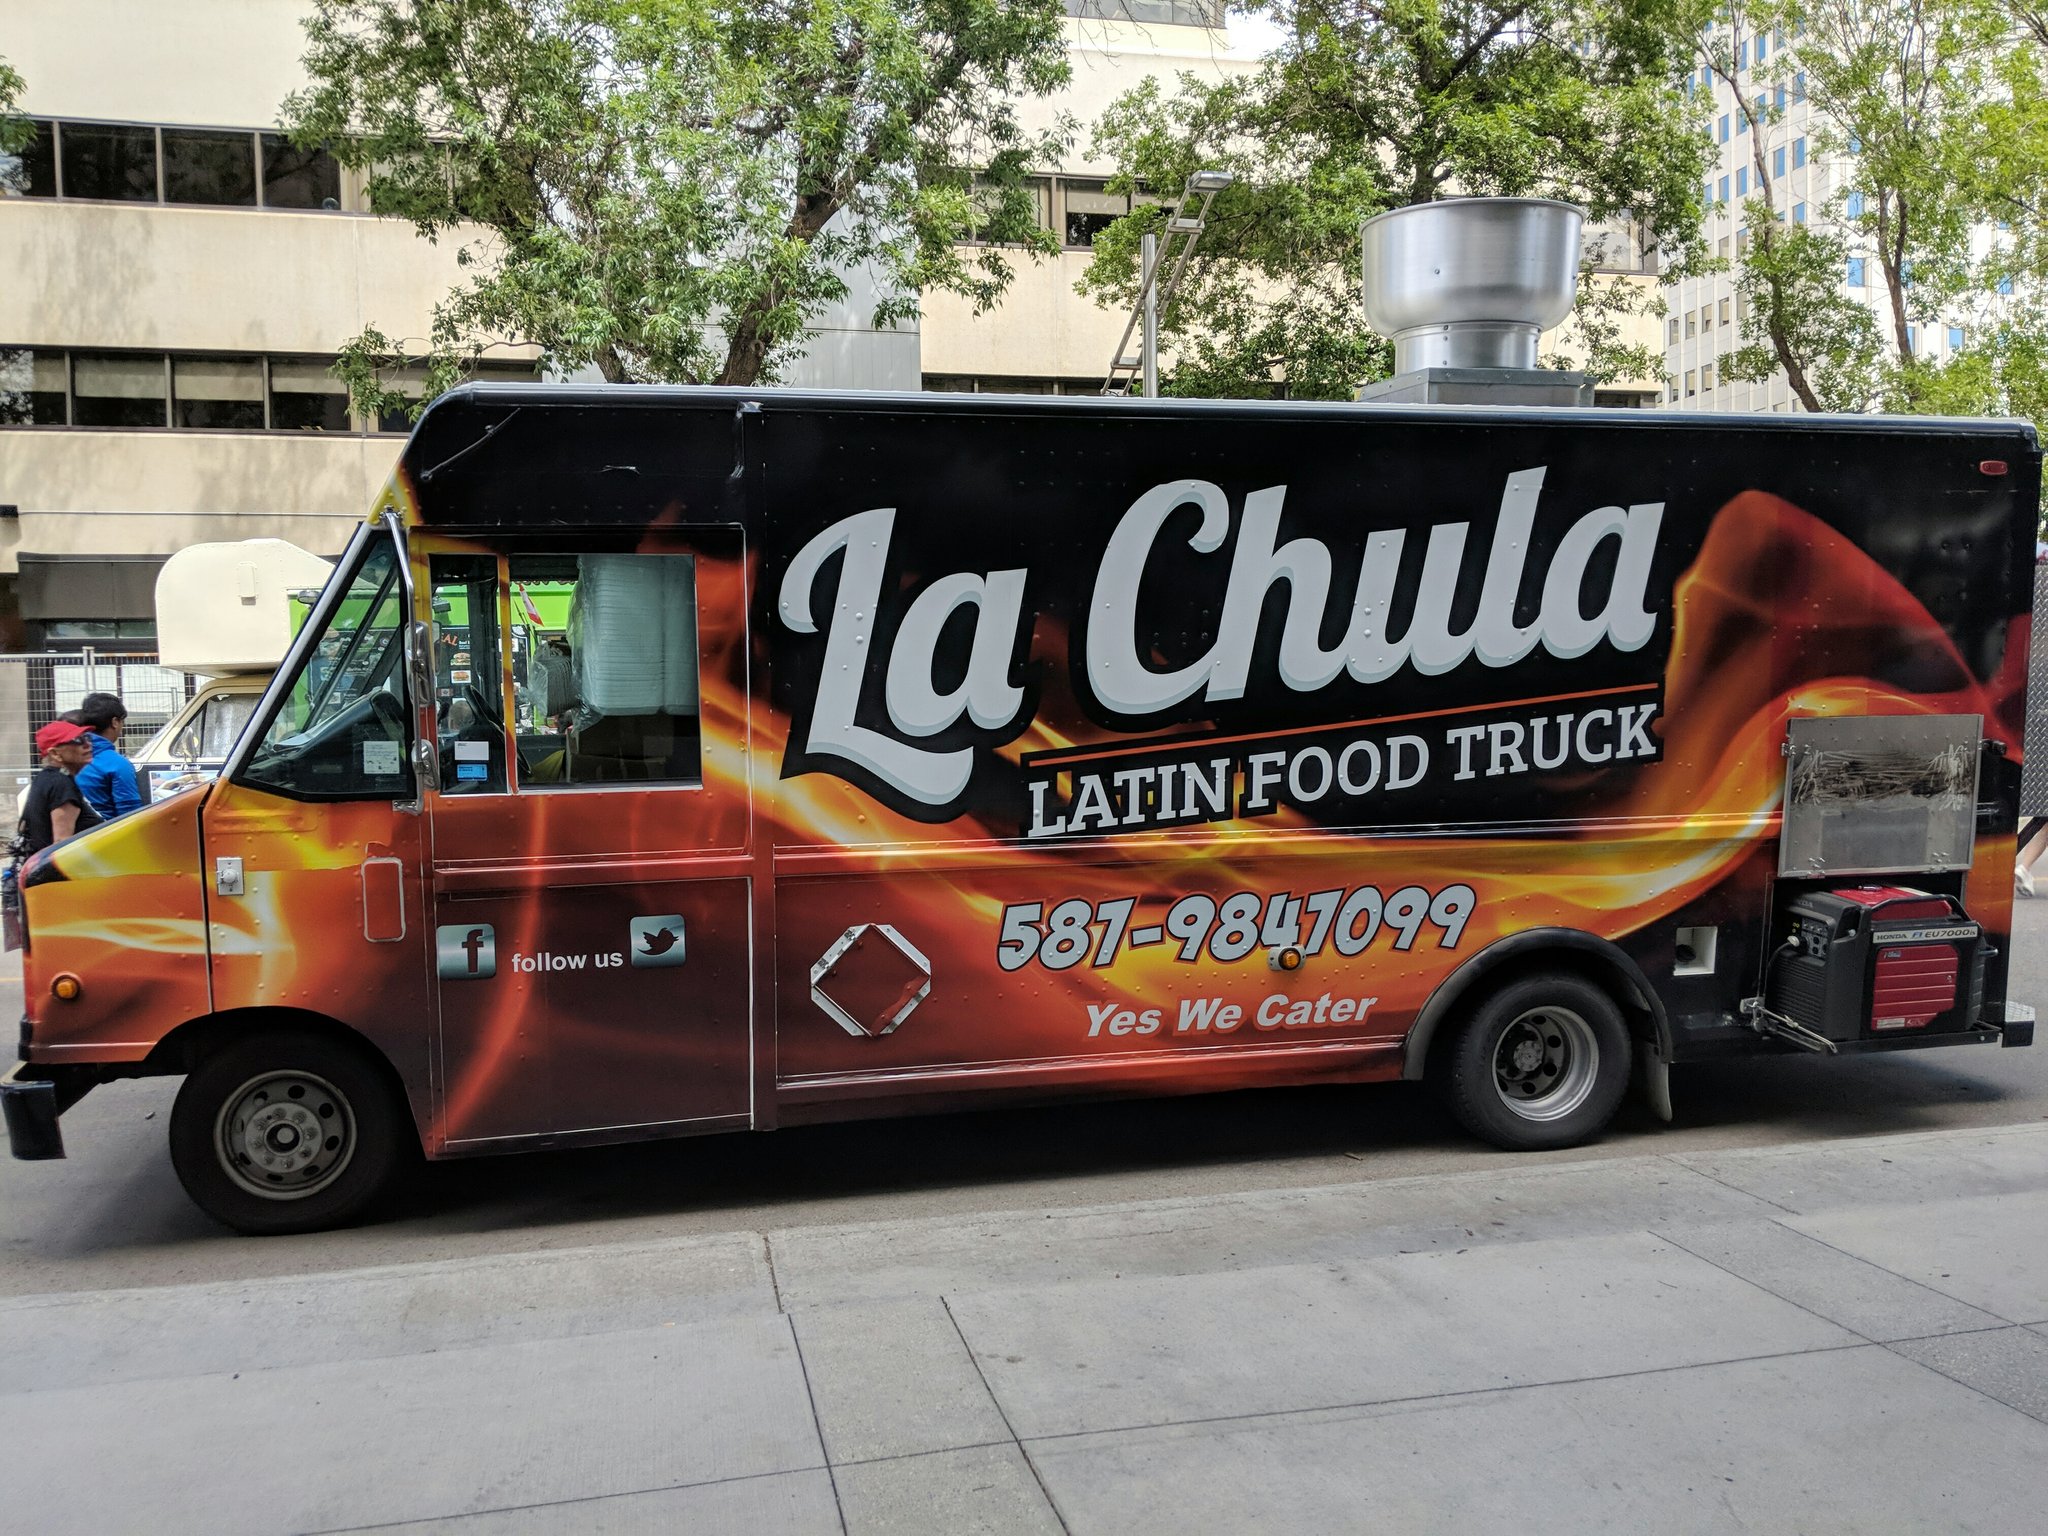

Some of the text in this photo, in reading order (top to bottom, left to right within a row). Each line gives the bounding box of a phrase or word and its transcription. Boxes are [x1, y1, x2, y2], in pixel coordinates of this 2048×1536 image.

[778, 465, 1666, 805] La Chula
[1028, 703, 1658, 838] LATIN FOOD TRUCK
[997, 883, 1476, 972] 587-9847099
[1876, 932, 1908, 940] HONDA
[511, 951, 624, 973] follow us
[1085, 994, 1377, 1037] Yes We Cater
